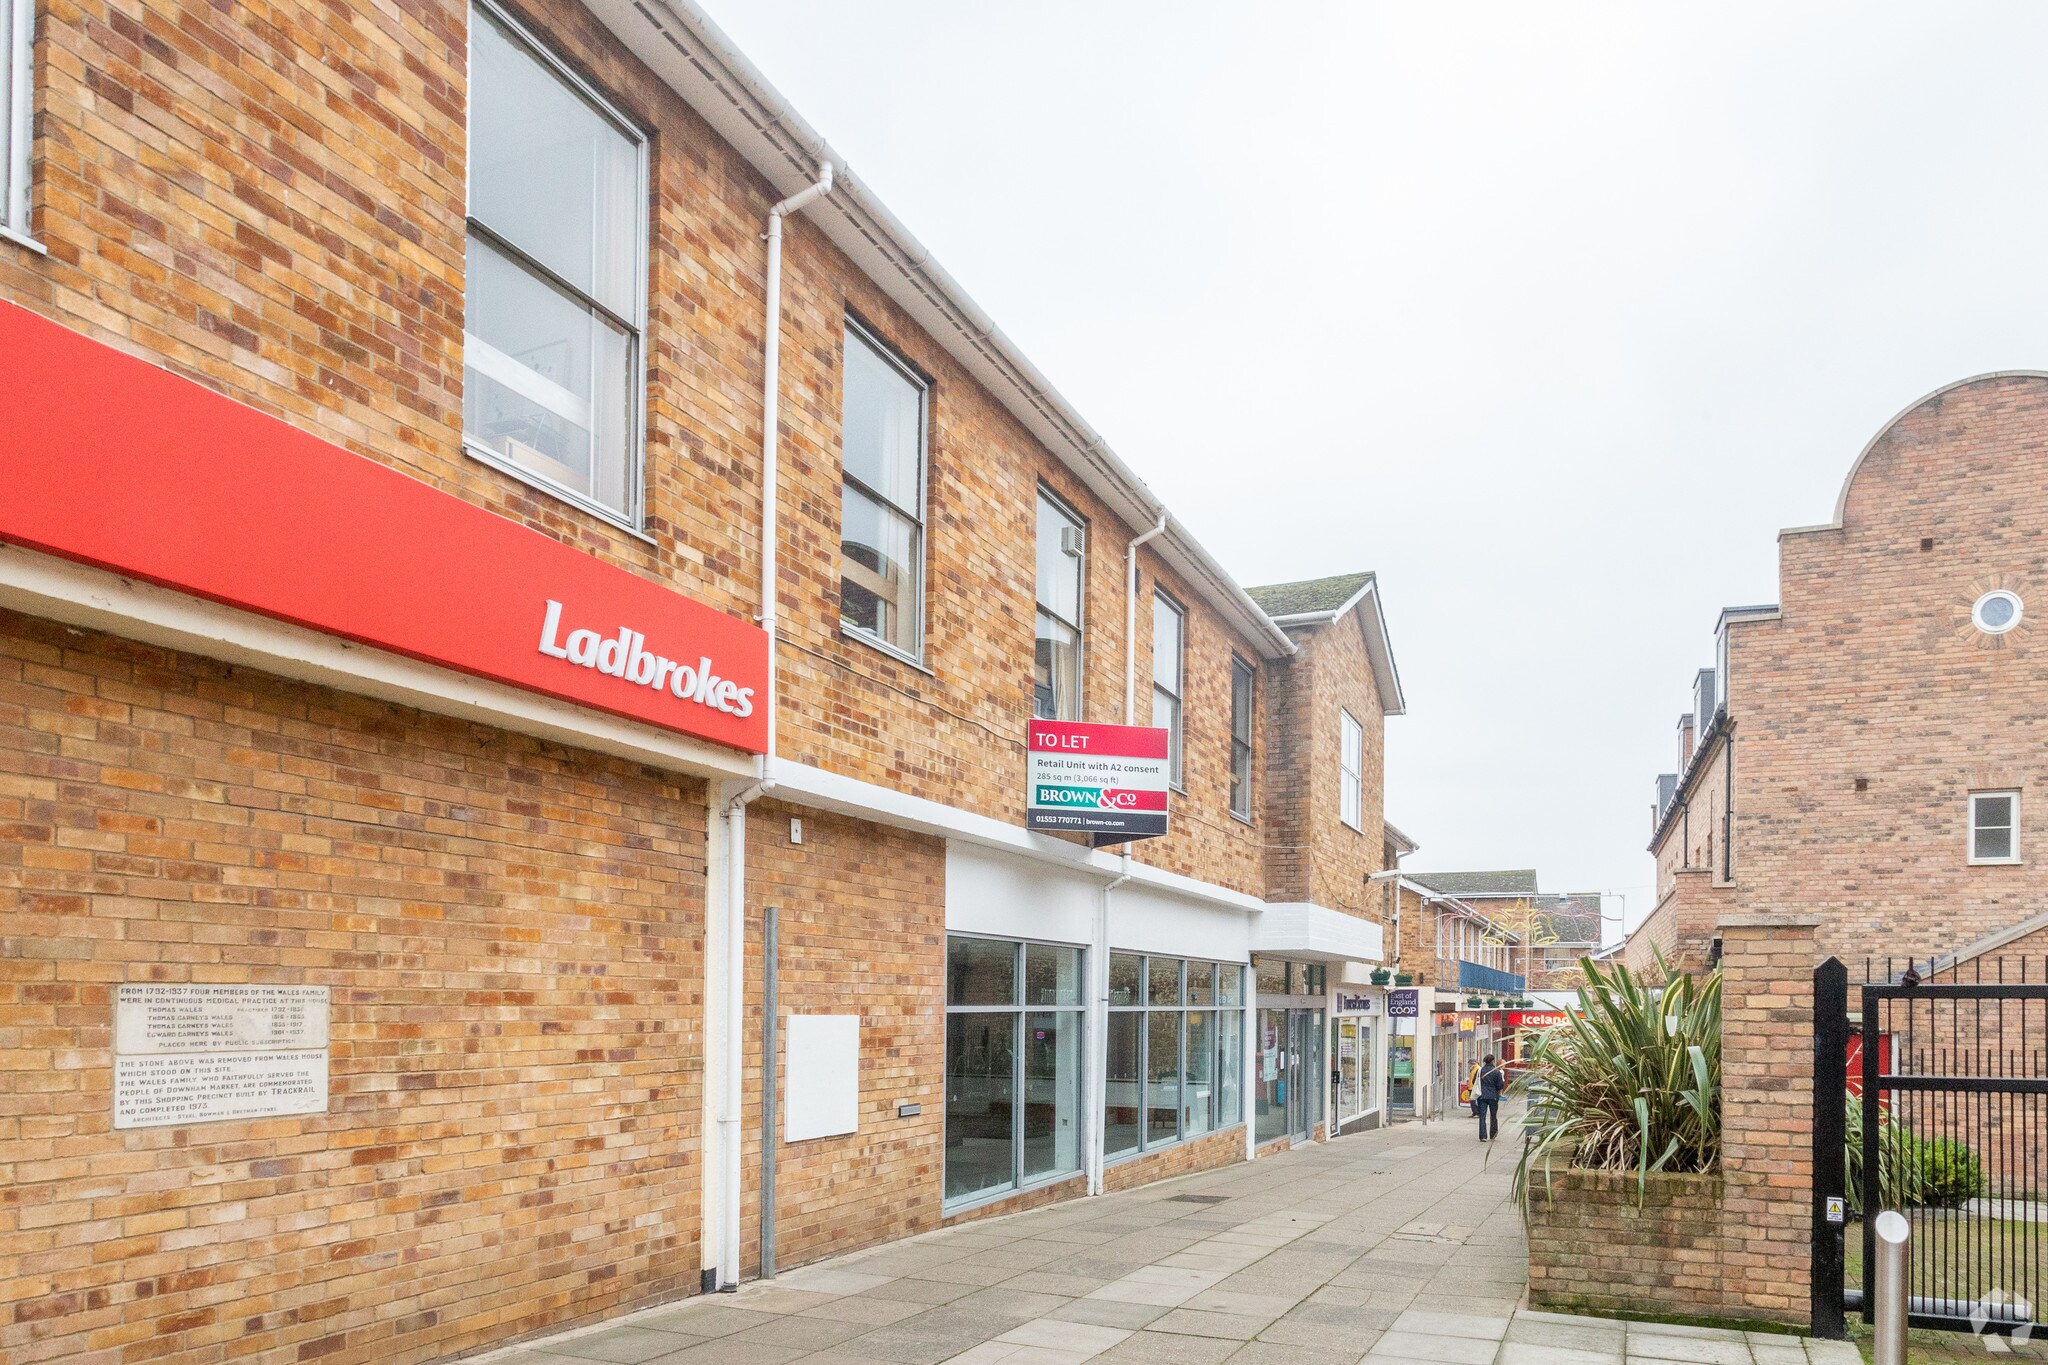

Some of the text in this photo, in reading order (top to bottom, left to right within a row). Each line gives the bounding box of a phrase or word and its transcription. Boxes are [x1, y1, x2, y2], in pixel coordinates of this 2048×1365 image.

[538, 600, 755, 718] Ladbrokes
[1036, 733, 1089, 749] TO LET
[1037, 760, 1159, 774] Retail Unit with A2 consent
[1074, 774, 1097, 783] (3,066
[1110, 776, 1119, 785] ft)
[167, 1085, 206, 1093] DOWNHAM
[259, 1079, 313, 1087] COMMEMORATED
[272, 1086, 315, 1095] TRACKRAIL
[140, 1105, 185, 1114] COMPLETED
